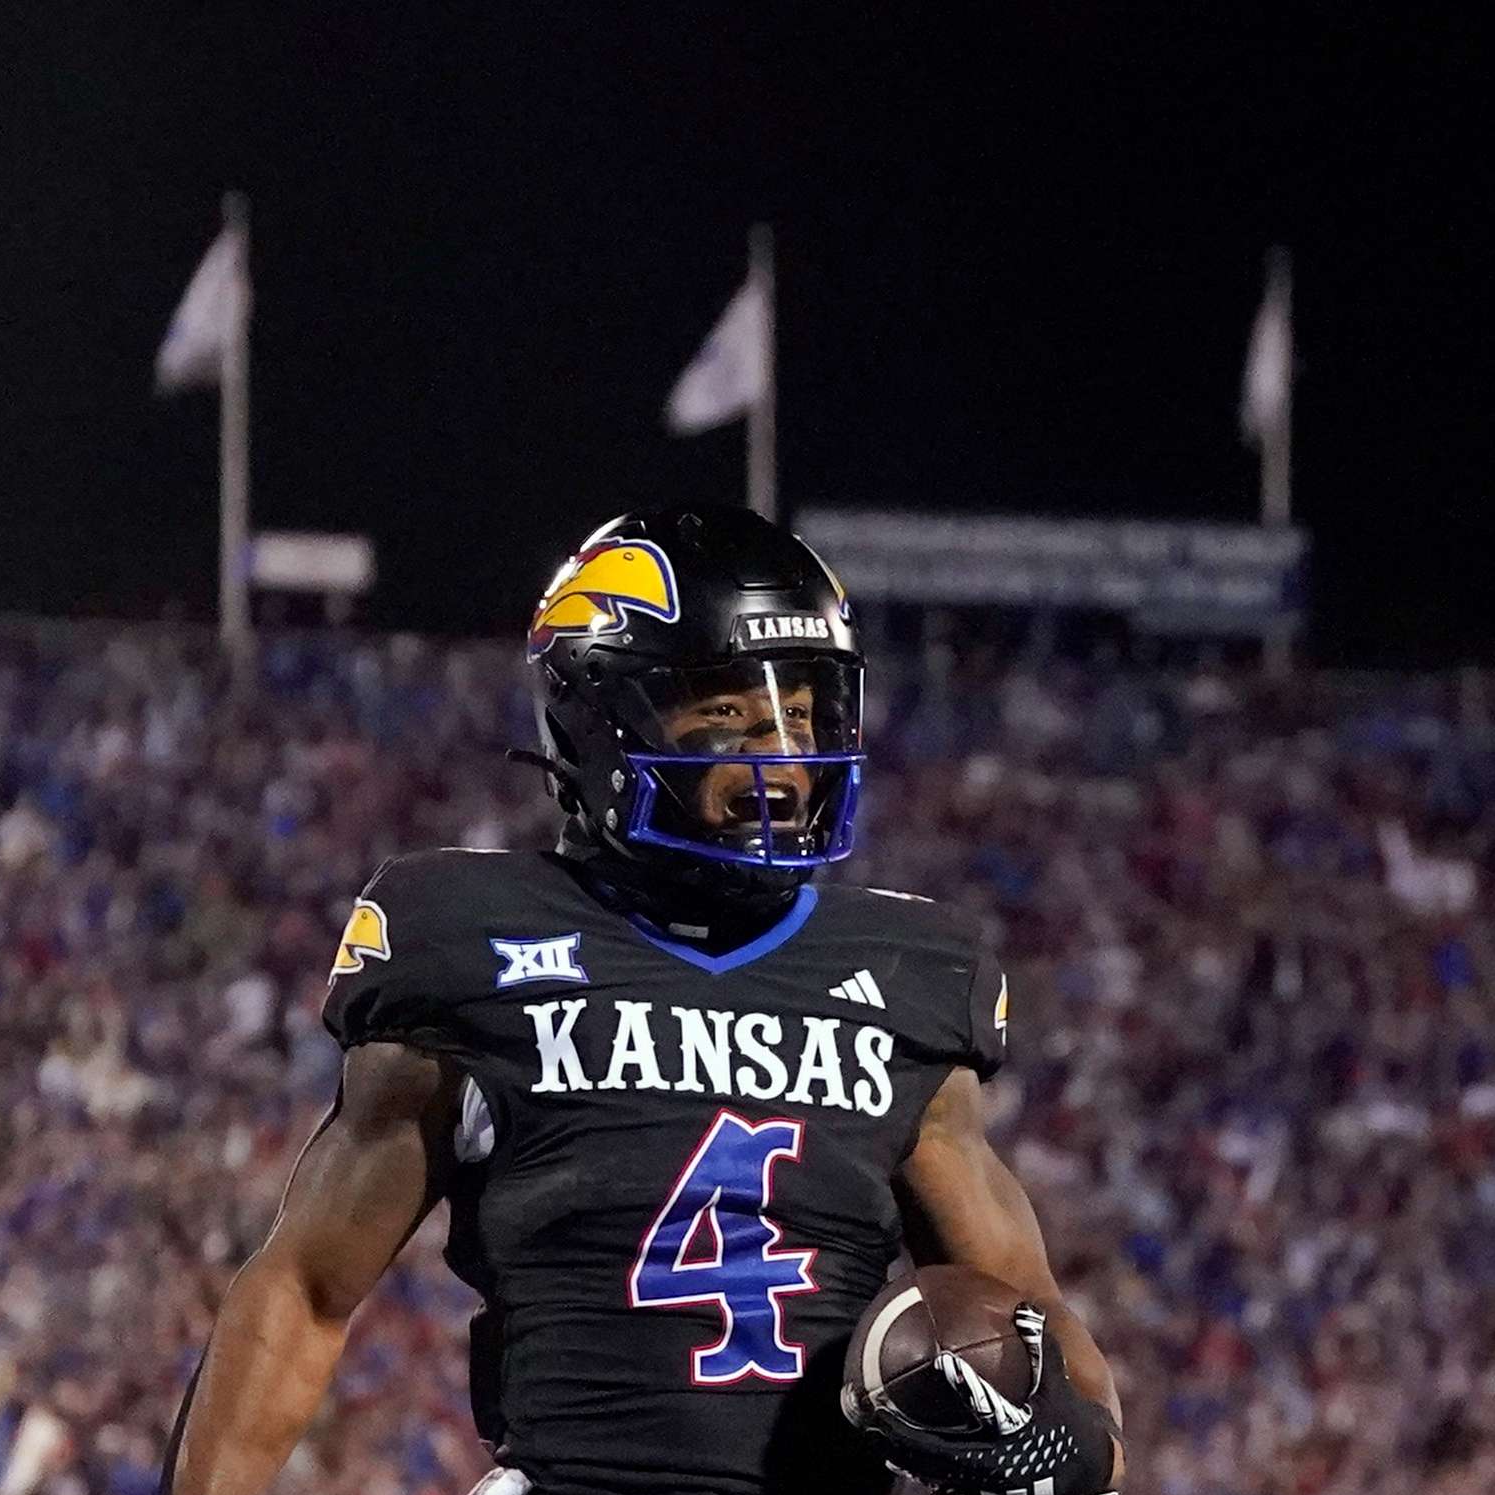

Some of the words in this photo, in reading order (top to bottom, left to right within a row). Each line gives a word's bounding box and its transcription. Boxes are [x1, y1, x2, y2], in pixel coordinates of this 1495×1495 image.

[746, 616, 829, 641] KANSAS
[489, 931, 590, 989] XII
[523, 997, 894, 1118] KANSAS
[626, 1107, 822, 1386] 4
